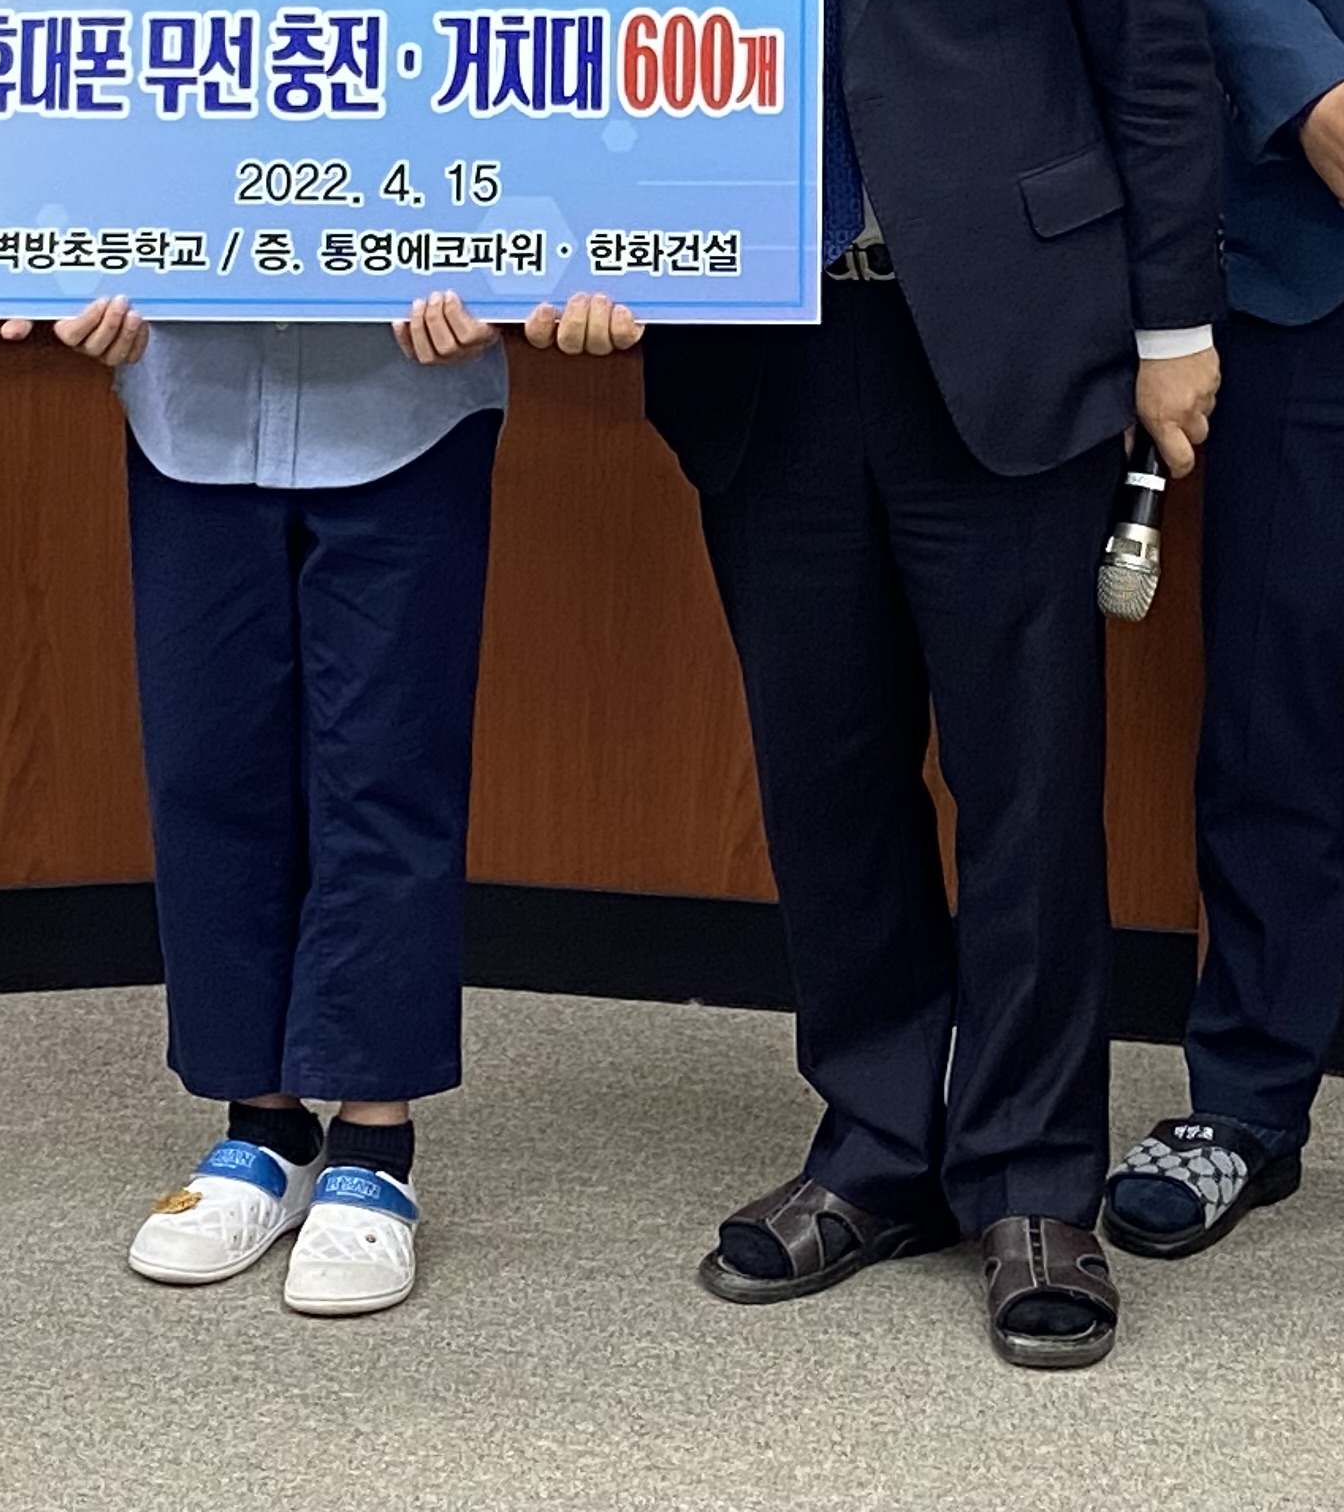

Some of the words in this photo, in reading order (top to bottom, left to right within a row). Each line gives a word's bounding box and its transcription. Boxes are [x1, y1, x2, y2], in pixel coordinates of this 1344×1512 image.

[146, 16, 252, 113] 무선
[437, 16, 603, 113] 거치대
[624, 14, 778, 112] 600개
[238, 164, 364, 204] 2022.
[449, 164, 499, 204] 15
[322, 232, 544, 274] 통영에코파워
[589, 232, 741, 273] 한화건설
